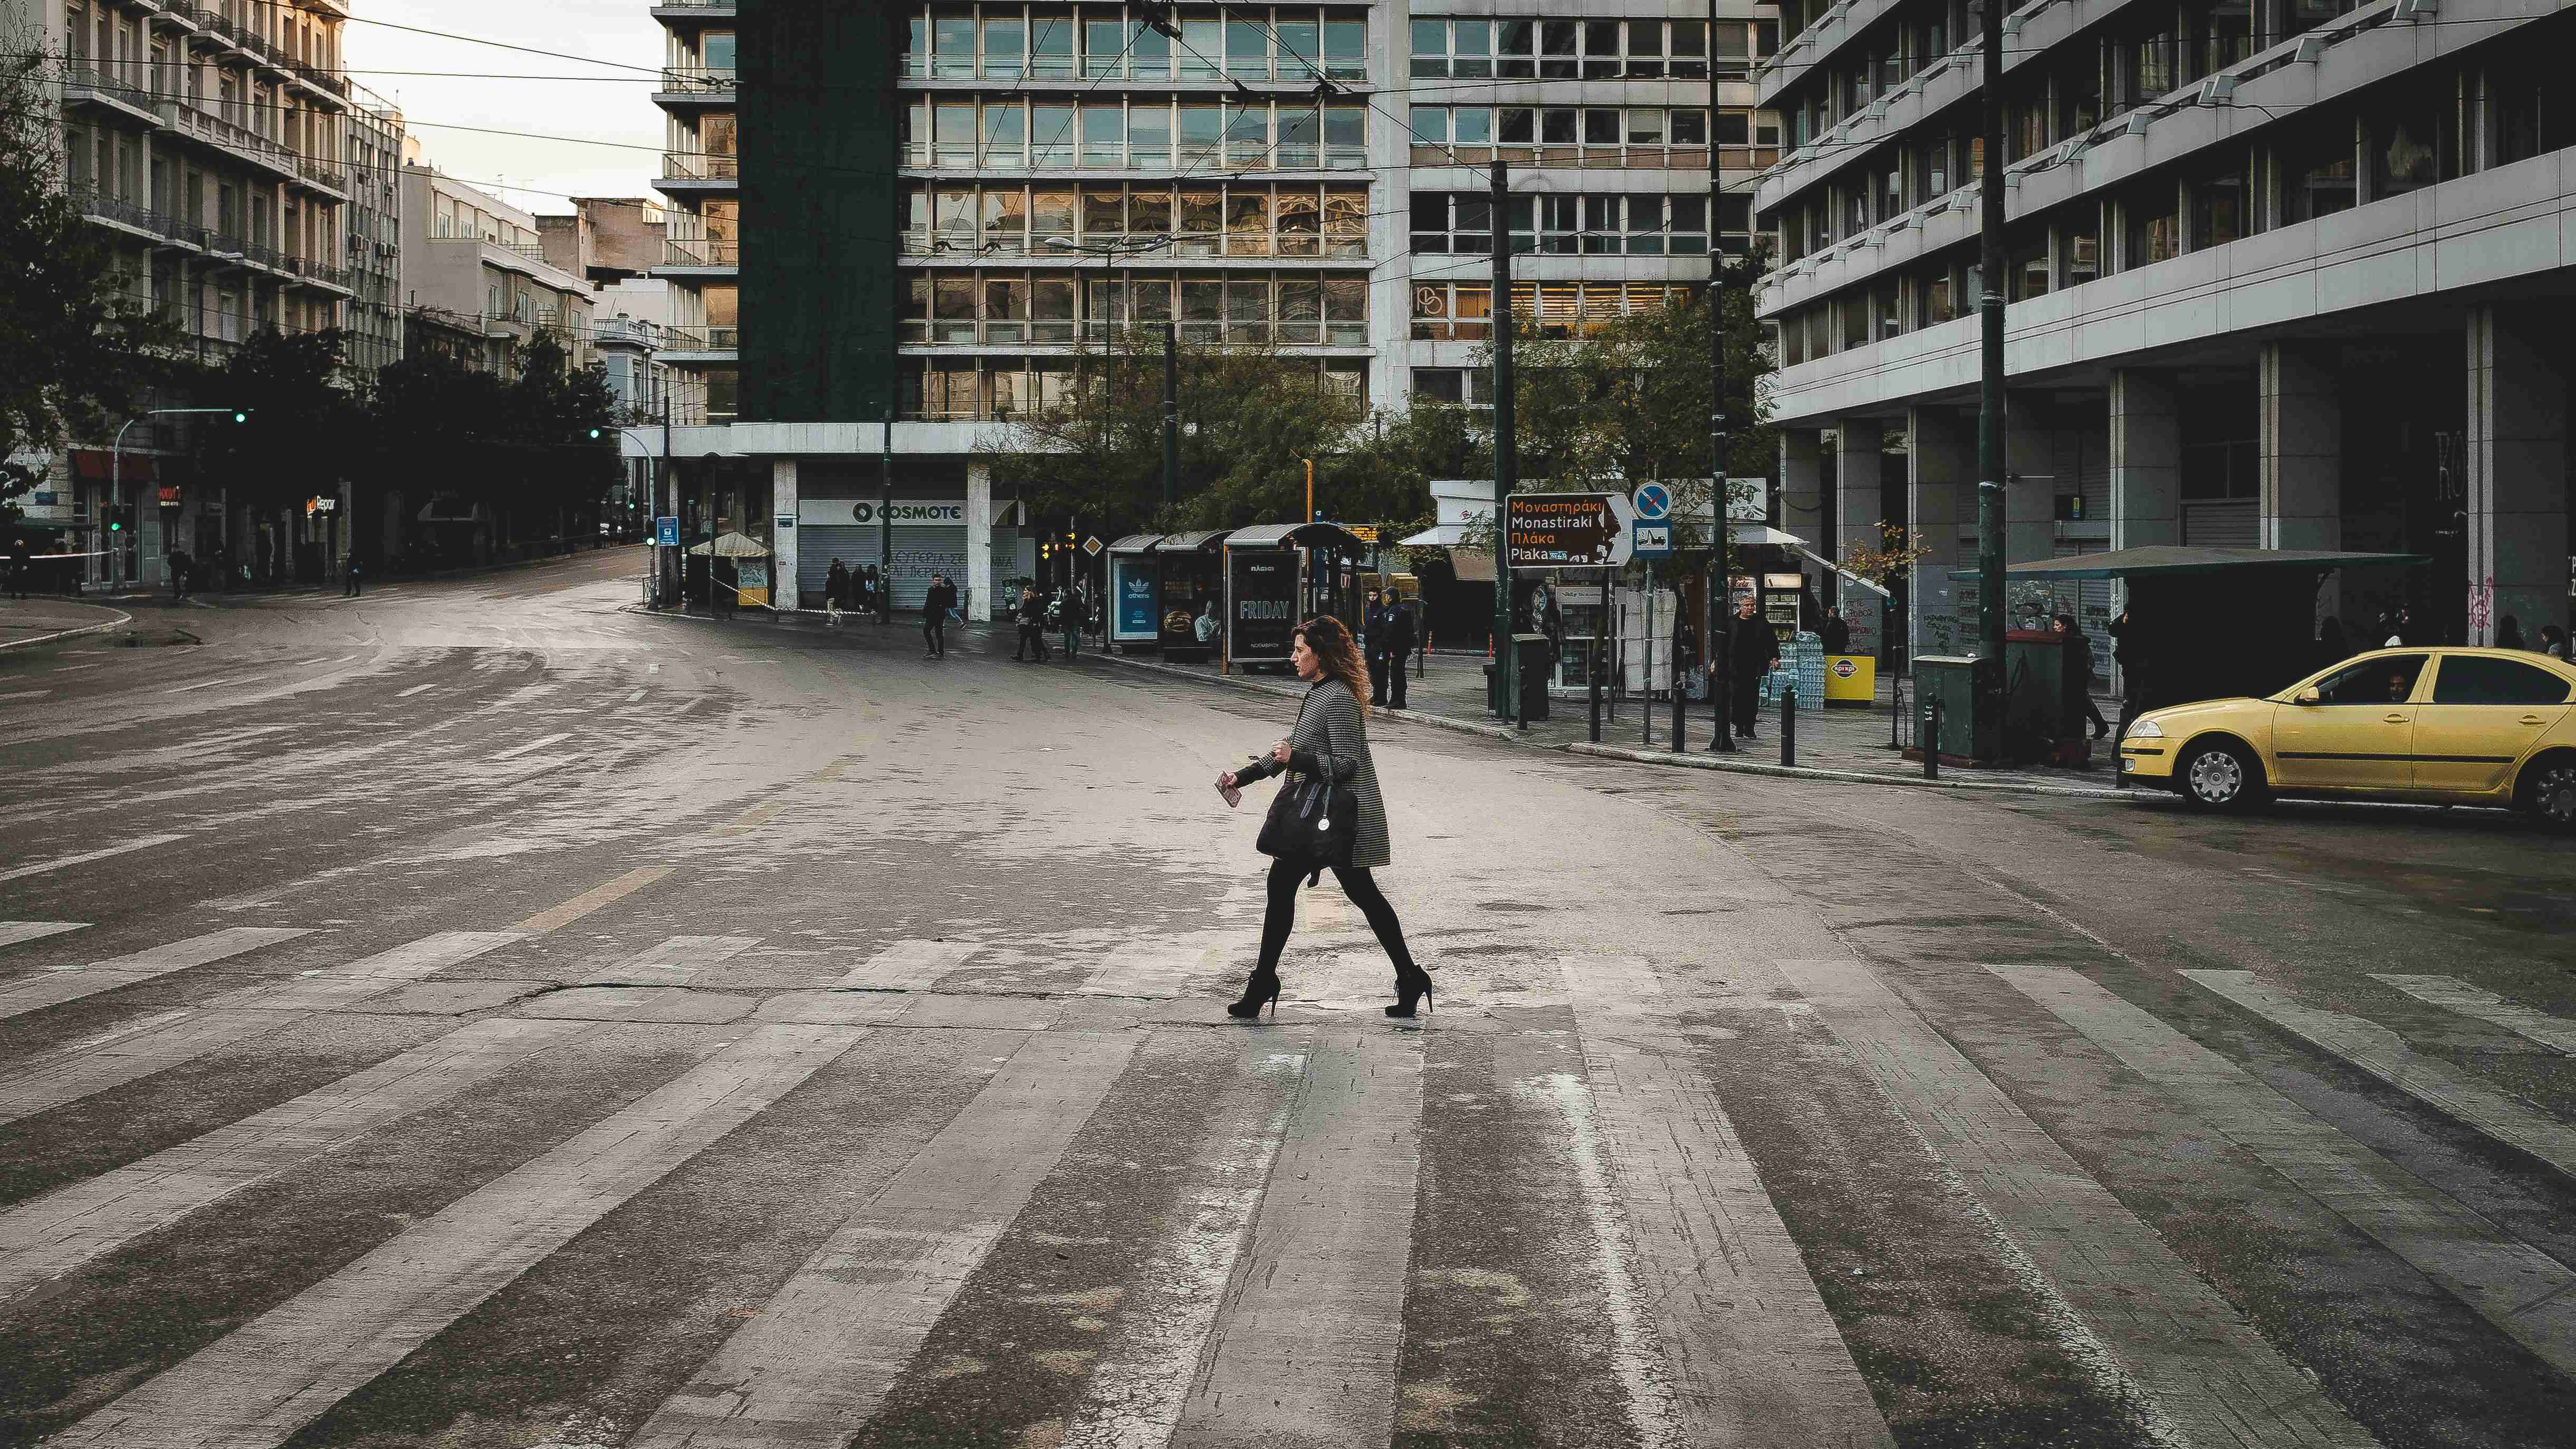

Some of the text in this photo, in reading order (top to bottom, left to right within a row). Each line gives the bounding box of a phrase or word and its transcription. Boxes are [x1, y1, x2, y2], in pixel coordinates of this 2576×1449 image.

[876, 505, 962, 520] COSMOTE
[1512, 499, 1602, 515] Μοναστηράκι
[1512, 515, 1592, 528] Monastiraki
[1511, 531, 1555, 544] Πλάκα
[1511, 548, 1548, 560] Plaka
[1240, 601, 1289, 619] FRIDAY
